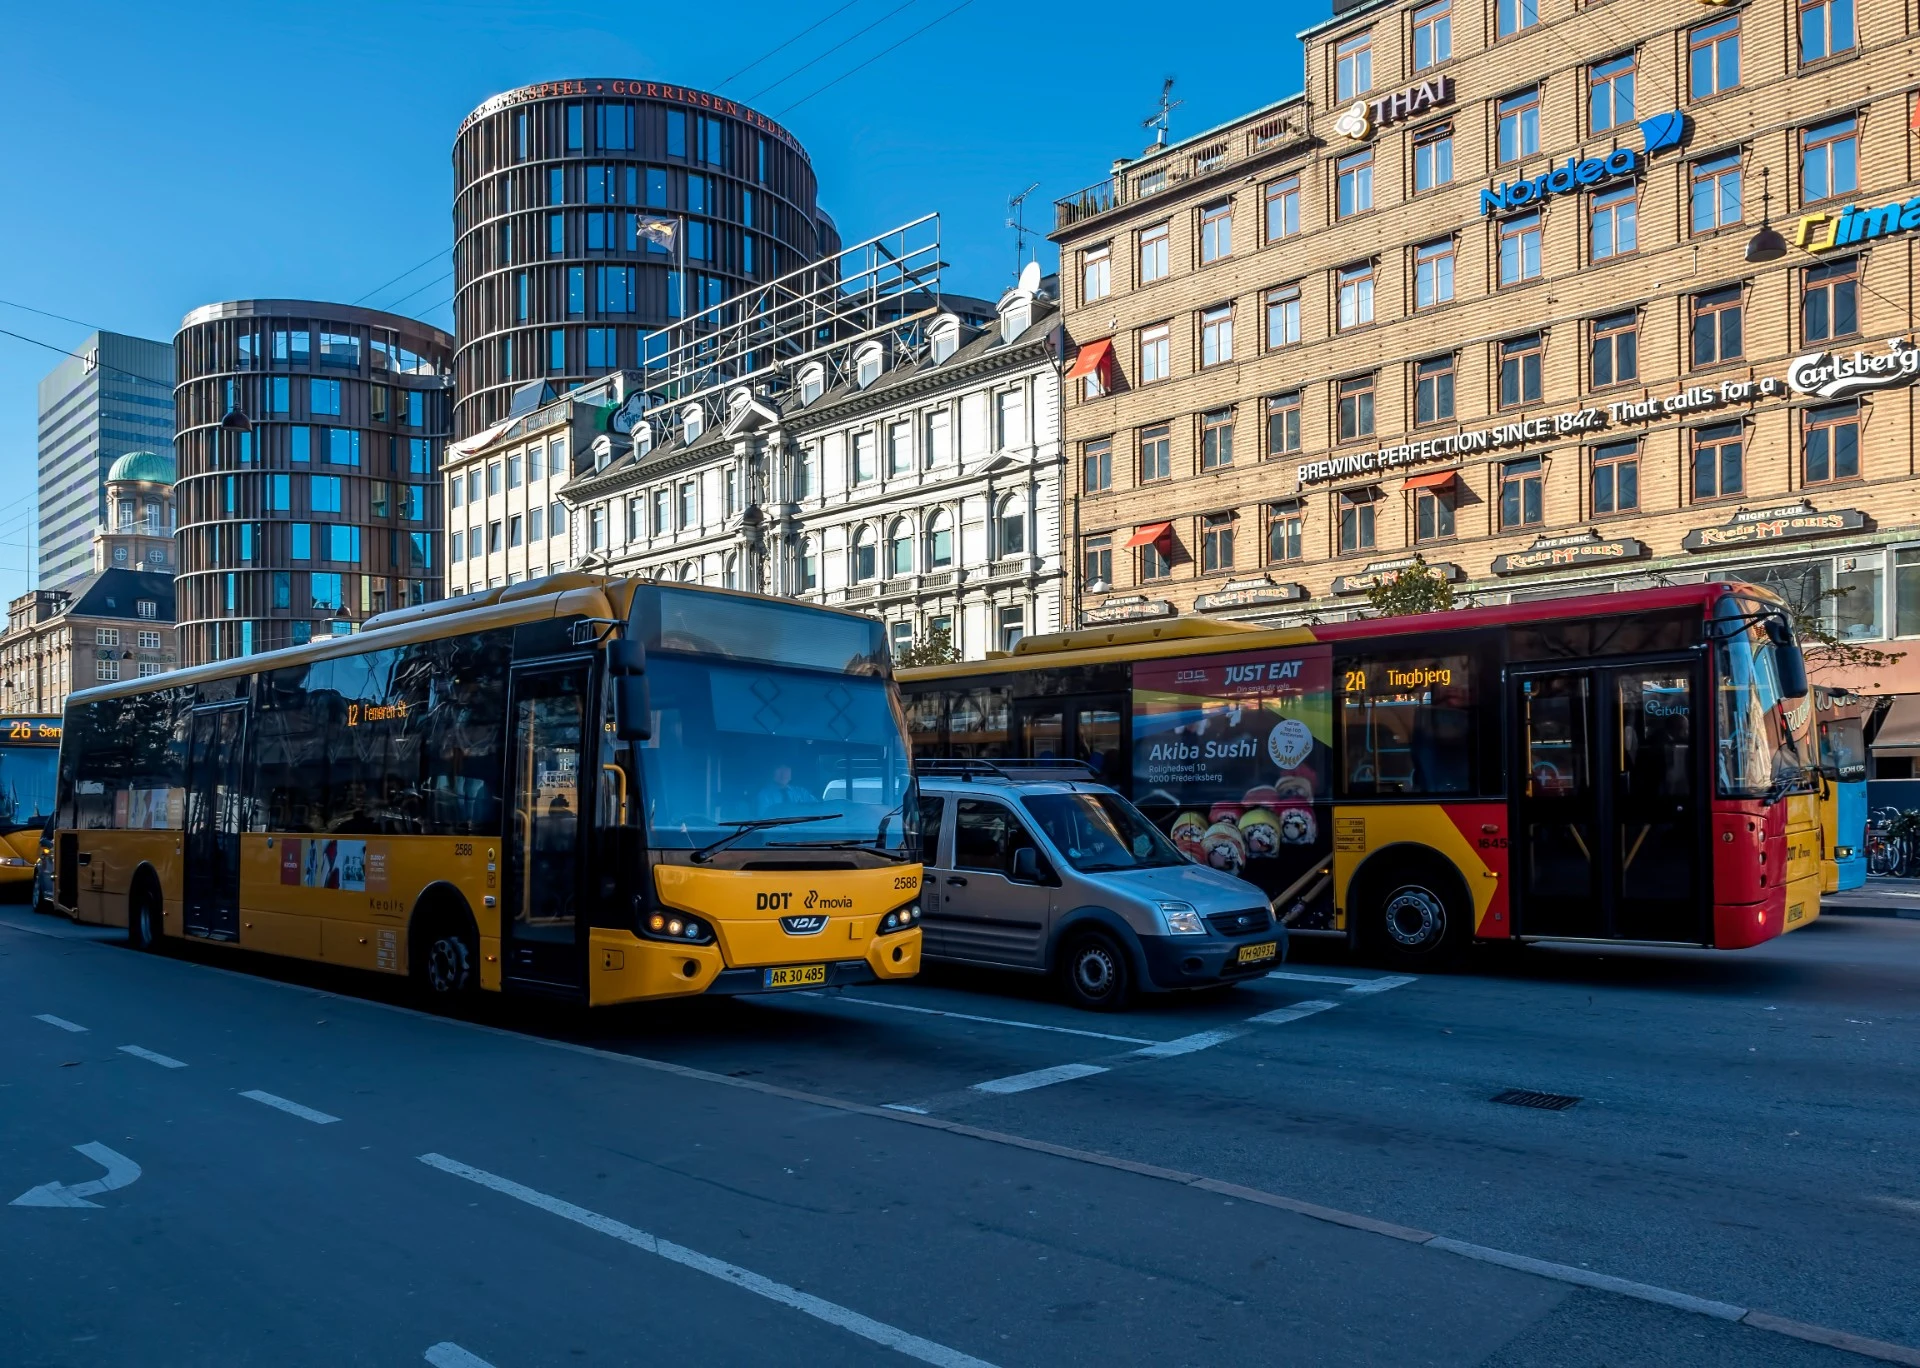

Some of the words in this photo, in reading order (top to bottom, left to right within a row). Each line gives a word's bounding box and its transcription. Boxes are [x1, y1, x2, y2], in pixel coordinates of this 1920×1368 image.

[613, 80, 737, 116] GORRISSEN
[1369, 75, 1447, 125] THAI
[1480, 148, 1635, 216] Nordea
[1298, 452, 1373, 483] BREWING
[1377, 430, 1487, 467] PERFECTION
[1493, 417, 1549, 445] SINCE
[1554, 408, 1602, 431] 1847.
[1610, 398, 1658, 422] That
[1664, 387, 1714, 412] calls
[1720, 380, 1753, 401] for
[1760, 376, 1777, 394] a
[1788, 344, 1920, 395] Carlsberg
[1738, 510, 1771, 521] NIGHT
[1774, 506, 1804, 517] CLUB
[1536, 539, 1557, 548] LIVE
[1559, 535, 1589, 545] MUSIC
[1224, 664, 1266, 686] JUST
[1269, 661, 1303, 680] EAT
[1345, 671, 1366, 691] 2A
[1387, 667, 1451, 688] Tingbjerg
[347, 704, 358, 727] 12
[10, 721, 31, 738] 26
[1149, 742, 1199, 760] Akiba
[1204, 738, 1258, 758] Sushi
[1149, 764, 1195, 774] Rolighedsvej
[1196, 763, 1206, 772] 10
[1149, 775, 1169, 783] 2000
[1171, 773, 1223, 782] Frederiksberg
[454, 843, 473, 856] 2588
[1478, 838, 1507, 848] 1645
[894, 876, 918, 890] 2588
[756, 892, 789, 910] DOT
[819, 895, 853, 909] movia
[787, 917, 820, 929] VDL
[1240, 949, 1251, 960] VH
[772, 970, 787, 984] AR
[789, 969, 803, 983] 30
[804, 967, 824, 981] 485
